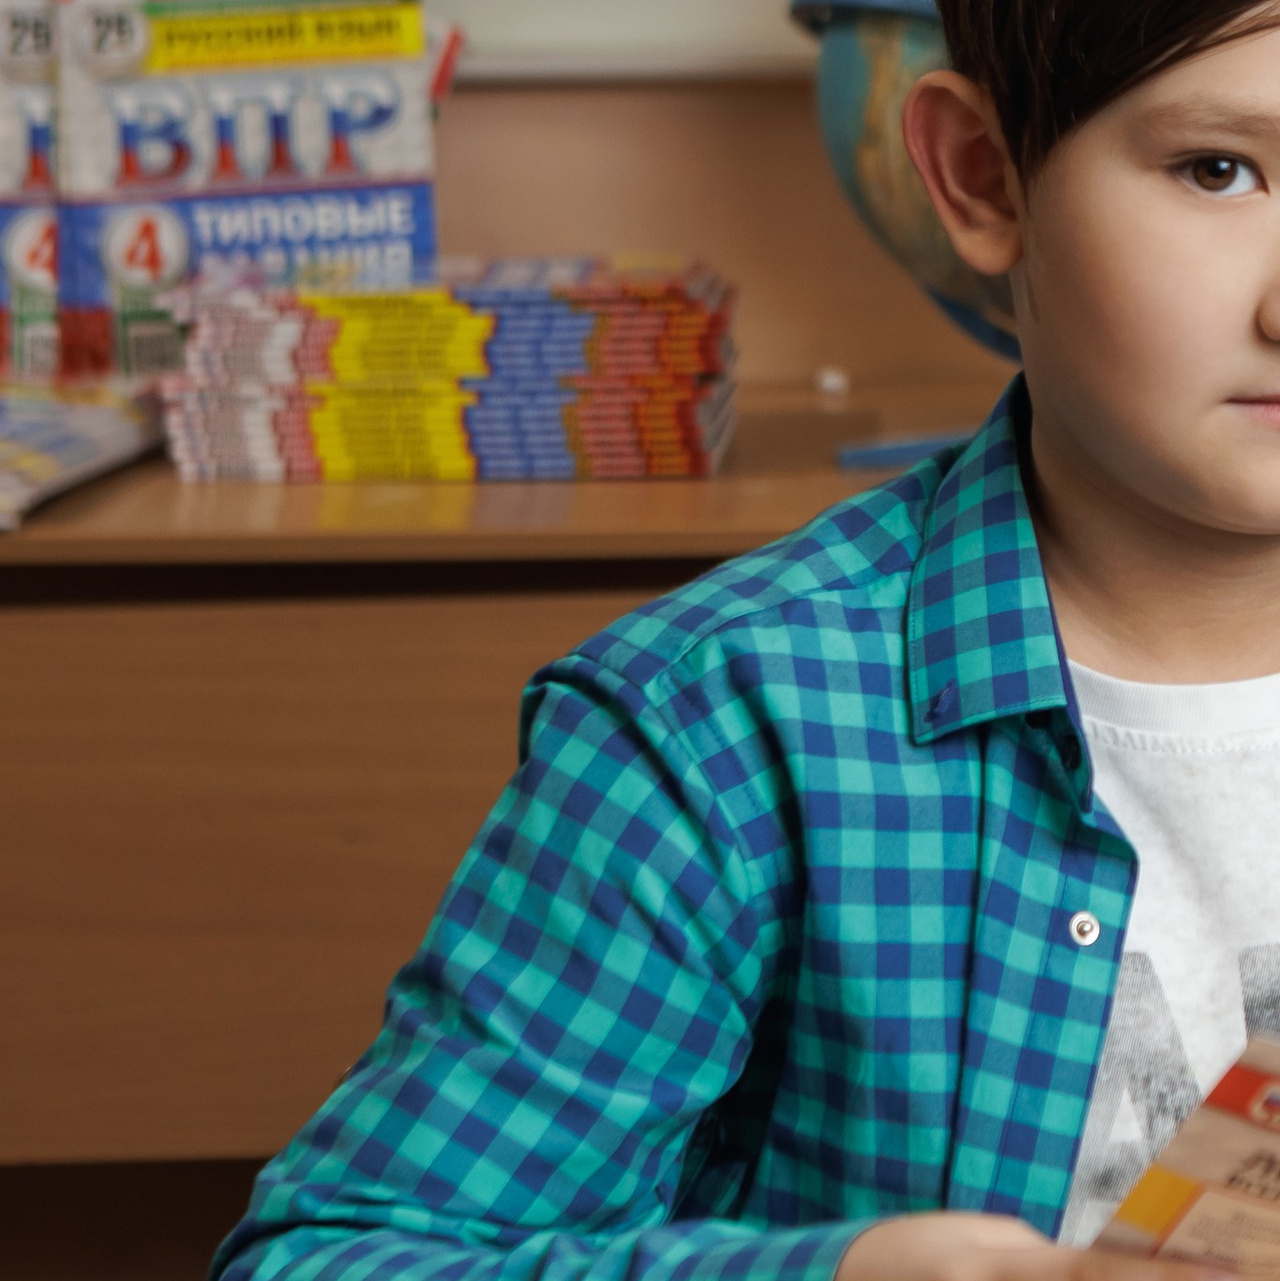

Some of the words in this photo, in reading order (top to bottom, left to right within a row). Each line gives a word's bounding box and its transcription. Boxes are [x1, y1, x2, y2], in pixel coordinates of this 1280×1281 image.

[107, 74, 398, 190] ВПР
[124, 217, 163, 280] 4
[195, 192, 416, 246] ТИПОВЫЕ
